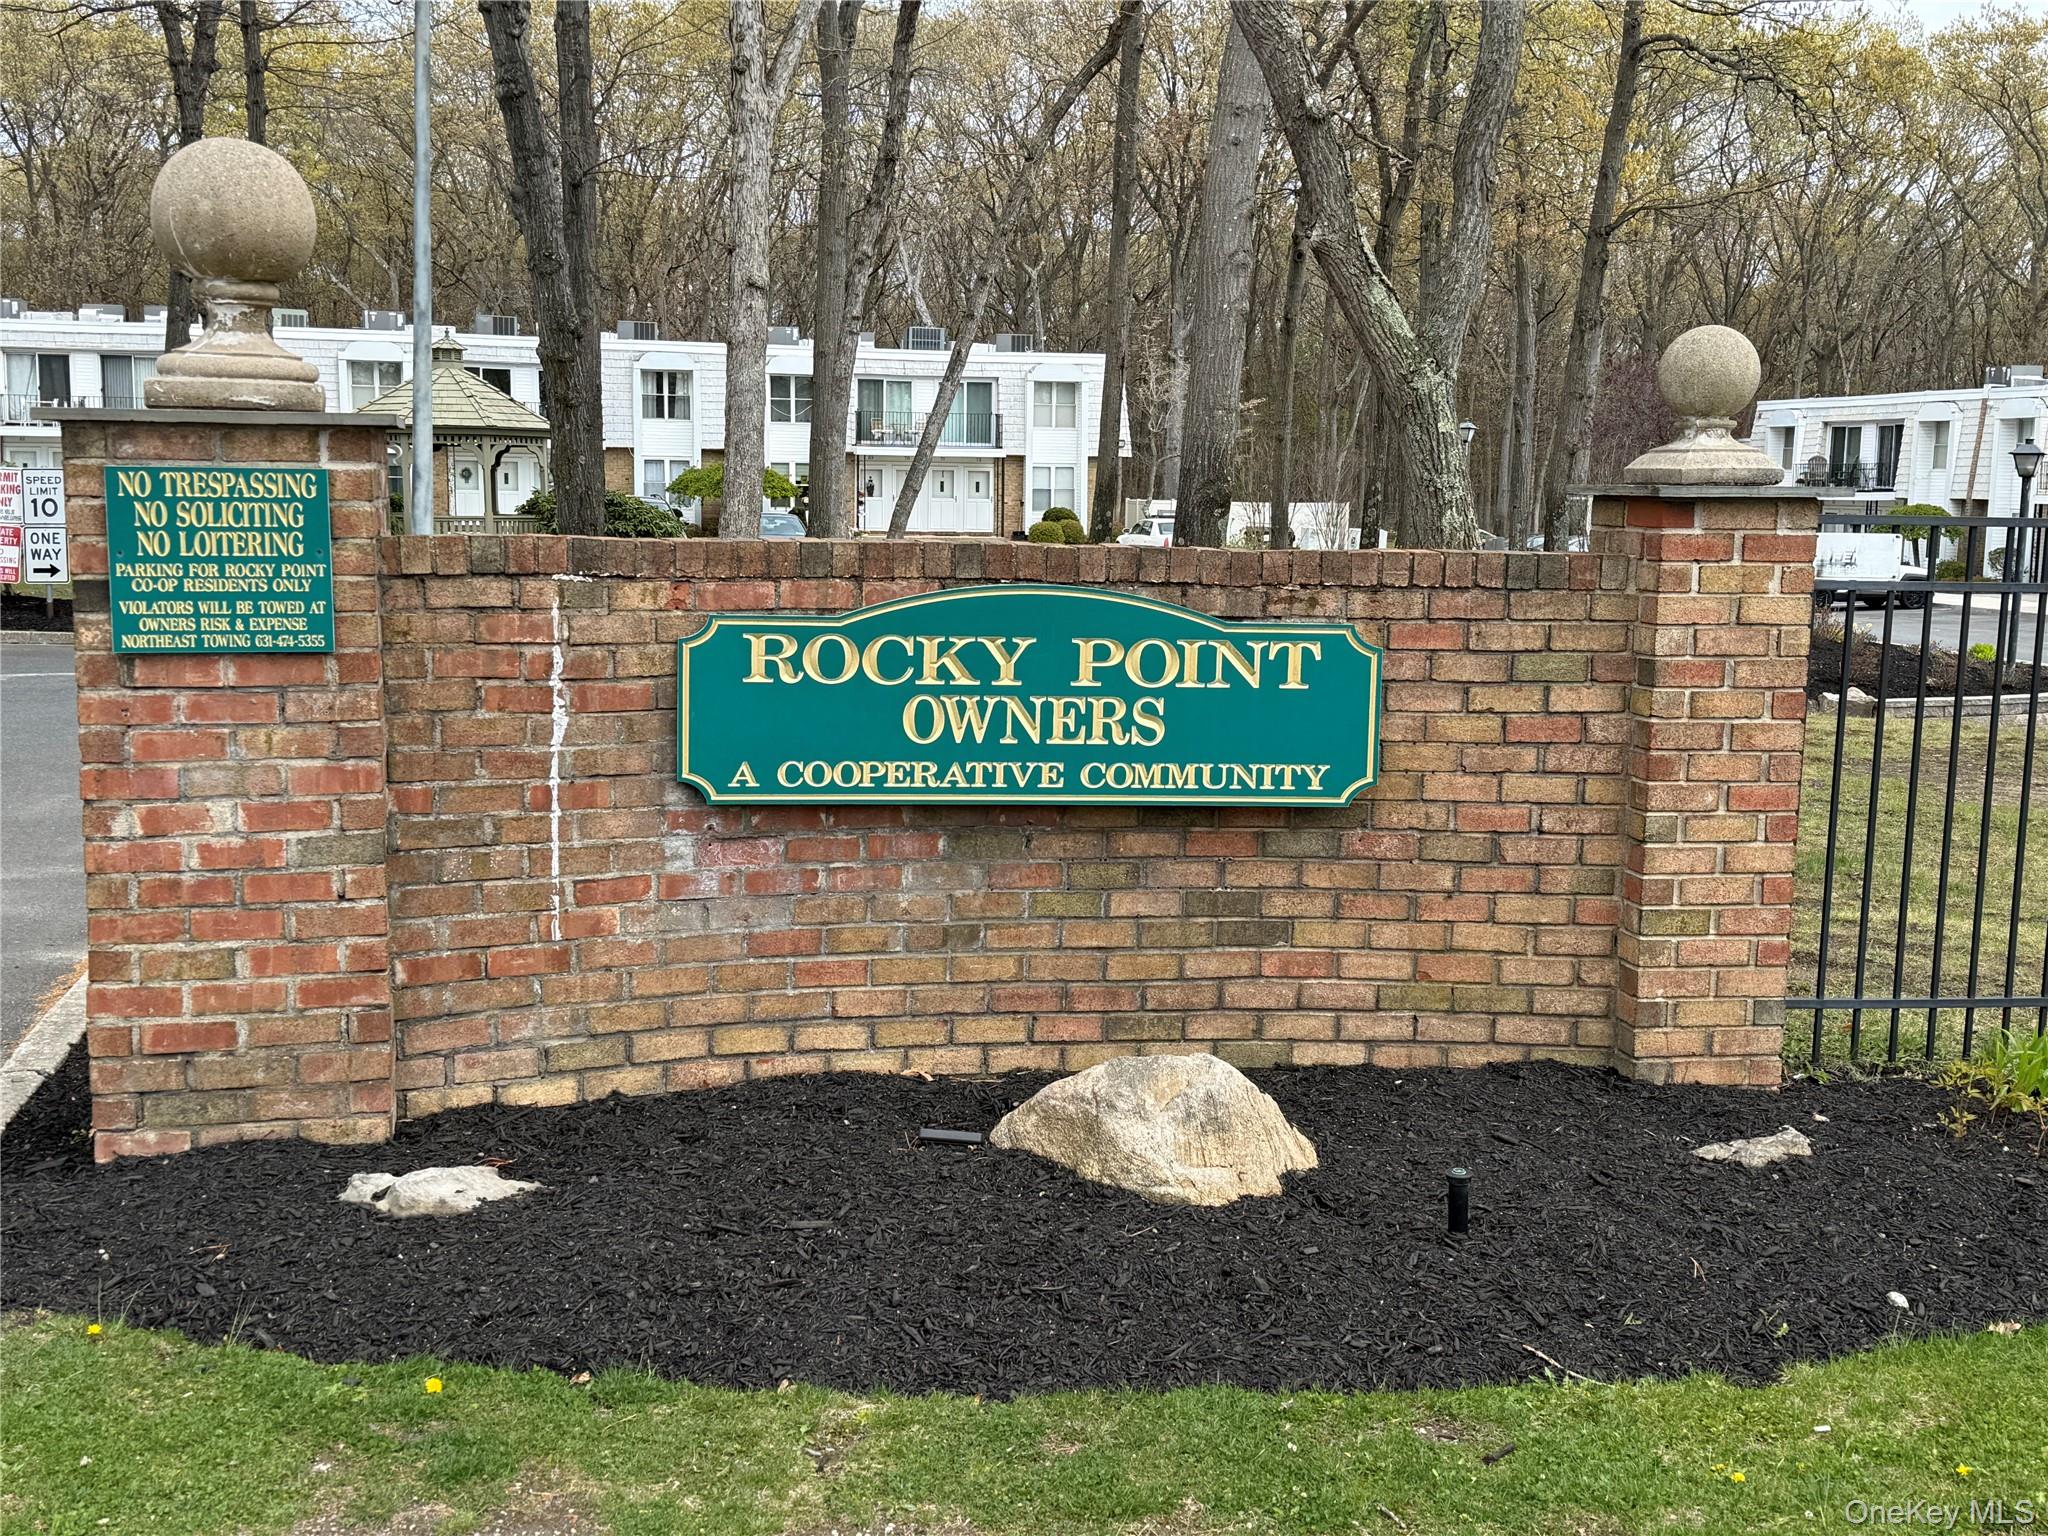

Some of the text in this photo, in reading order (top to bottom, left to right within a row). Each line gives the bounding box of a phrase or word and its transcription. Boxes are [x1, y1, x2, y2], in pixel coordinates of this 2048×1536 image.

[118, 471, 316, 498] NO TRESPASSING
[31, 498, 58, 517] 10
[134, 501, 304, 527] NO SOLICITING
[31, 533, 60, 544] ONE
[137, 531, 303, 557] NO LOITERING
[31, 549, 61, 560] WAY
[116, 563, 326, 577] PARKING FOR ROCKY POINT
[132, 578, 311, 592] CO-OP RESIDENTS ONLY
[119, 601, 326, 614] VIOLATORS WILL BE TOWED AT
[139, 617, 307, 631] OWNERS RISK & EXPENSE
[122, 634, 325, 648] NORTHEAST TOWING 631-474-5355
[743, 633, 1321, 689] ROCKY POINT
[903, 695, 1165, 746] OWNERS
[728, 761, 1330, 790] A COOPERATIVE COMMUNITY
